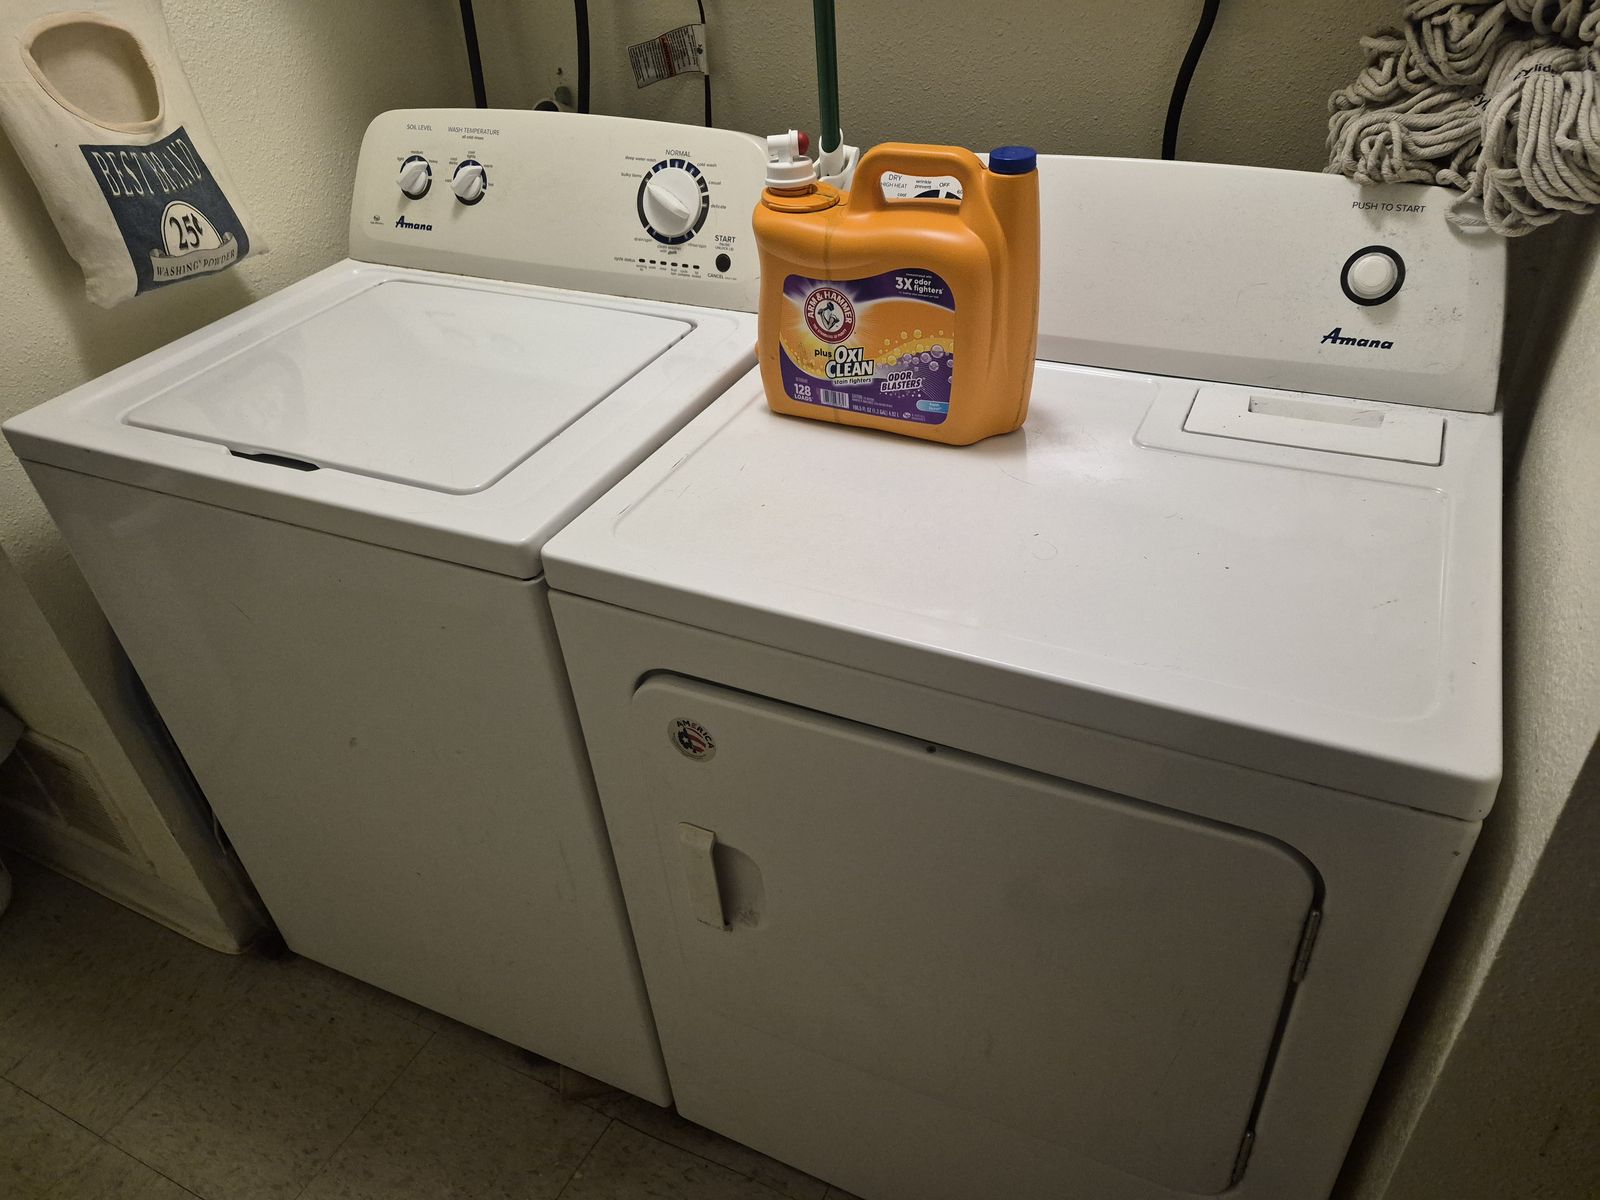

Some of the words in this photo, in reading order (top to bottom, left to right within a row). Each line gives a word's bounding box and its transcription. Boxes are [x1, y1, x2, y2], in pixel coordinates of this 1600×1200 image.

[406, 123, 417, 131] SOIL
[418, 124, 432, 132] LEVEL
[464, 127, 500, 136] TEMPERATURE
[665, 149, 691, 158] NORMAL
[91, 150, 154, 197] BEST
[142, 138, 202, 195] BRAND
[888, 173, 902, 182] DRY
[1351, 201, 1378, 211] PUSH
[1381, 203, 1394, 212] TO
[1396, 204, 1427, 214] START
[395, 215, 433, 232] Amana
[169, 213, 203, 251] 25¢
[714, 234, 736, 243] START
[156, 260, 201, 278] WASHING
[203, 249, 236, 269] POWDER
[708, 272, 724, 280] CANCEL
[913, 278, 931, 286] odor
[895, 276, 913, 291] 3X
[807, 296, 819, 319] ARM
[815, 292, 824, 301] &
[823, 290, 853, 324] HAMMER
[1320, 327, 1394, 350] Amana
[814, 348, 832, 358] plus
[834, 345, 864, 363] OXI
[825, 359, 874, 379] CLEAN
[887, 370, 913, 381] ODOR
[849, 377, 872, 385] fighters
[881, 378, 922, 392] BLASTERS
[793, 383, 812, 397] 128
[676, 719, 714, 749] AMERICA
